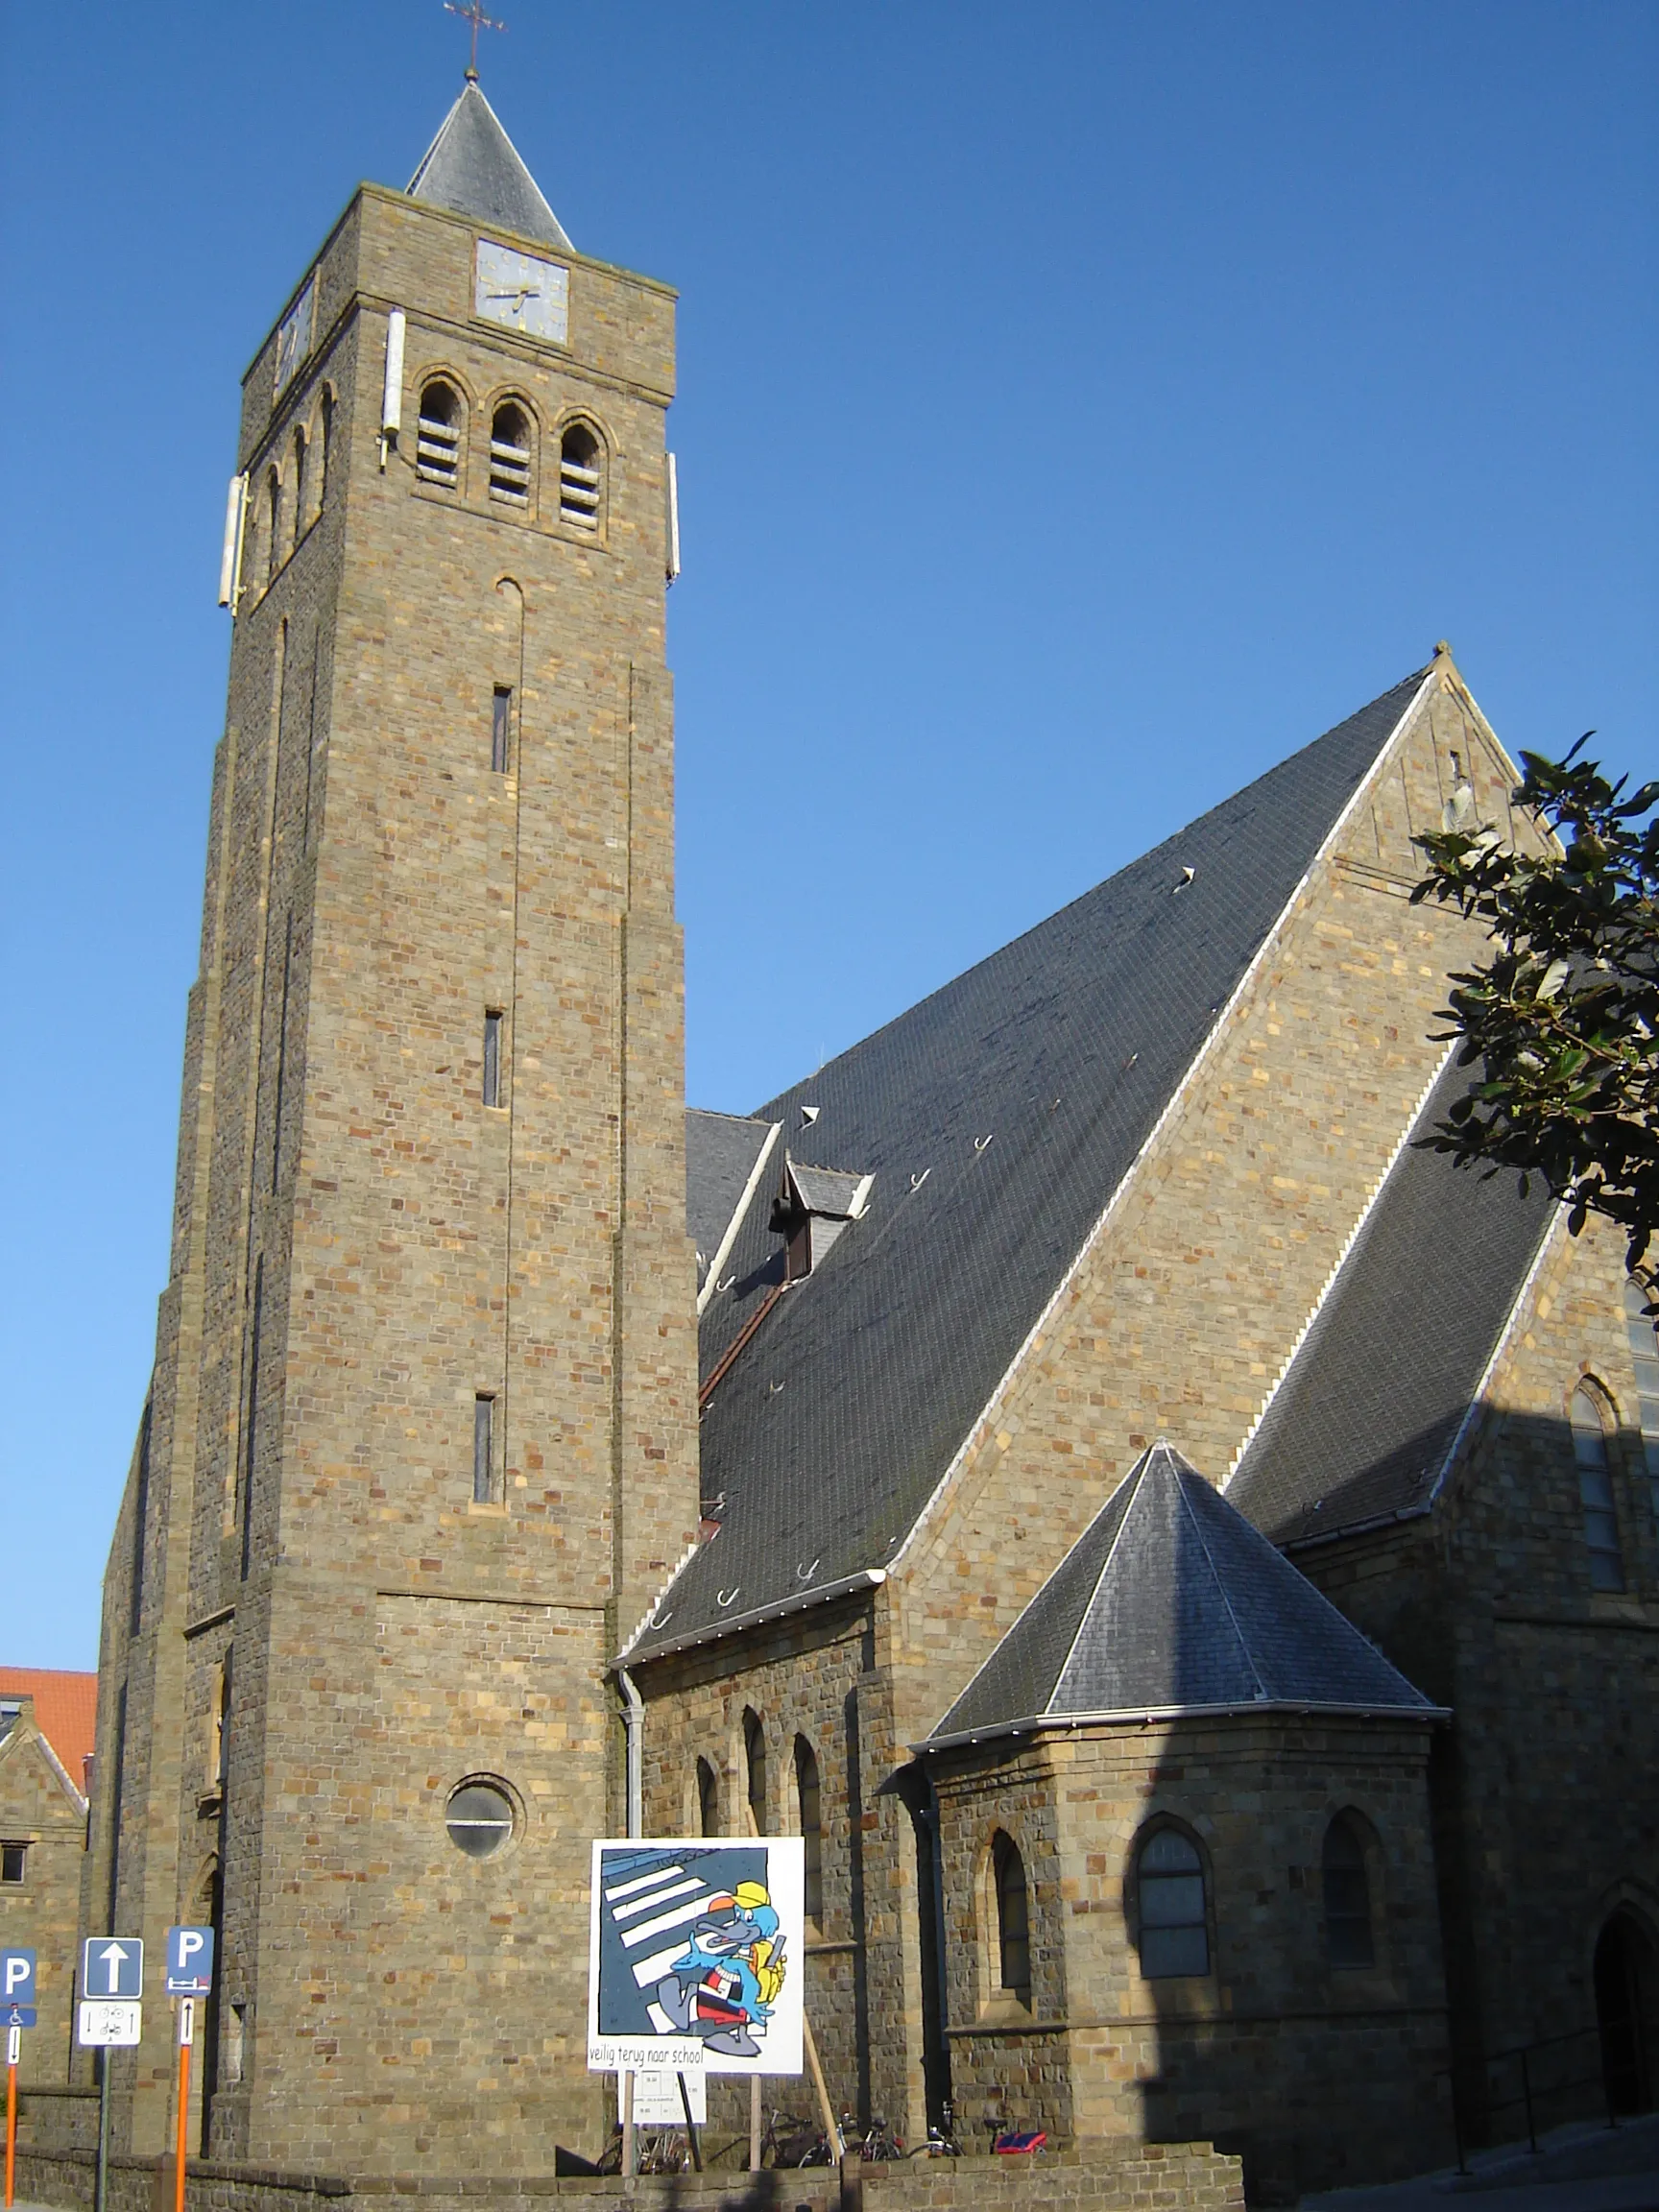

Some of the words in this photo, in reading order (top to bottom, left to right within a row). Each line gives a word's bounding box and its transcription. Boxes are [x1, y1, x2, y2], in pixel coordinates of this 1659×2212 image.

[179, 1931, 204, 1967] P
[6, 1958, 31, 1994] P
[589, 2044, 615, 2066] veilig
[618, 2047, 644, 2067] terug
[648, 2050, 669, 2063] naar
[672, 2045, 704, 2064] school
